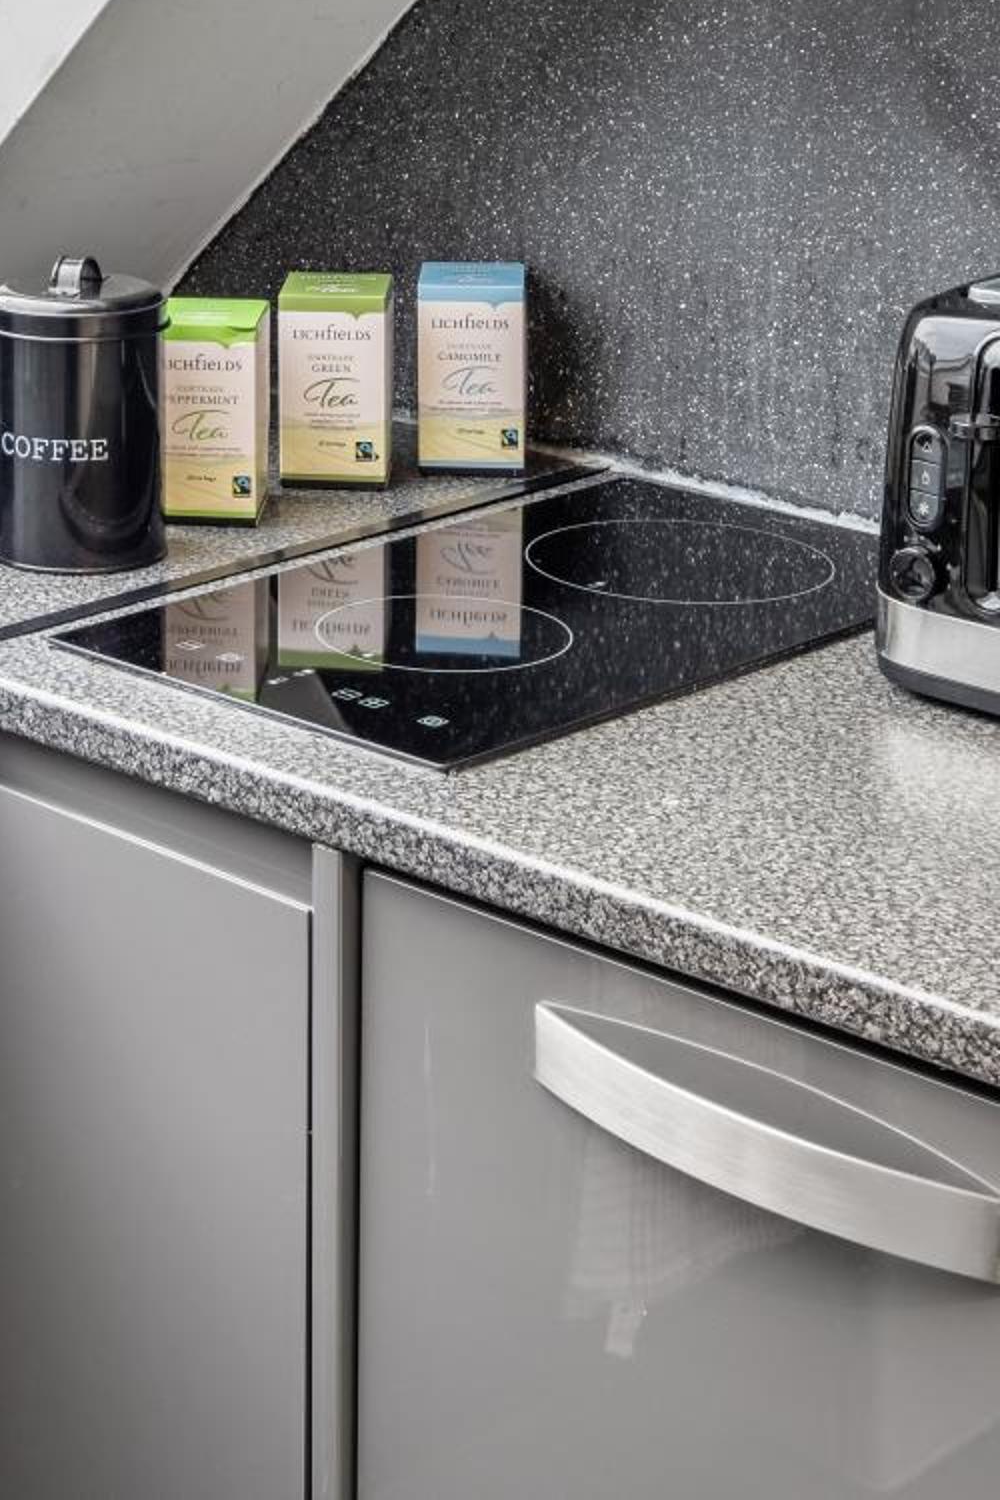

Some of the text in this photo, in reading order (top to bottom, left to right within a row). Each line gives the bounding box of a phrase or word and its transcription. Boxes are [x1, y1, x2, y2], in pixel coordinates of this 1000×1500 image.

[311, 363, 352, 374] GREEN
[436, 351, 502, 363] CAMOMILE
[303, 377, 361, 409] Tea
[440, 365, 500, 395] Tea
[171, 408, 231, 441] Tea
[1, 431, 110, 462] COFFEE
